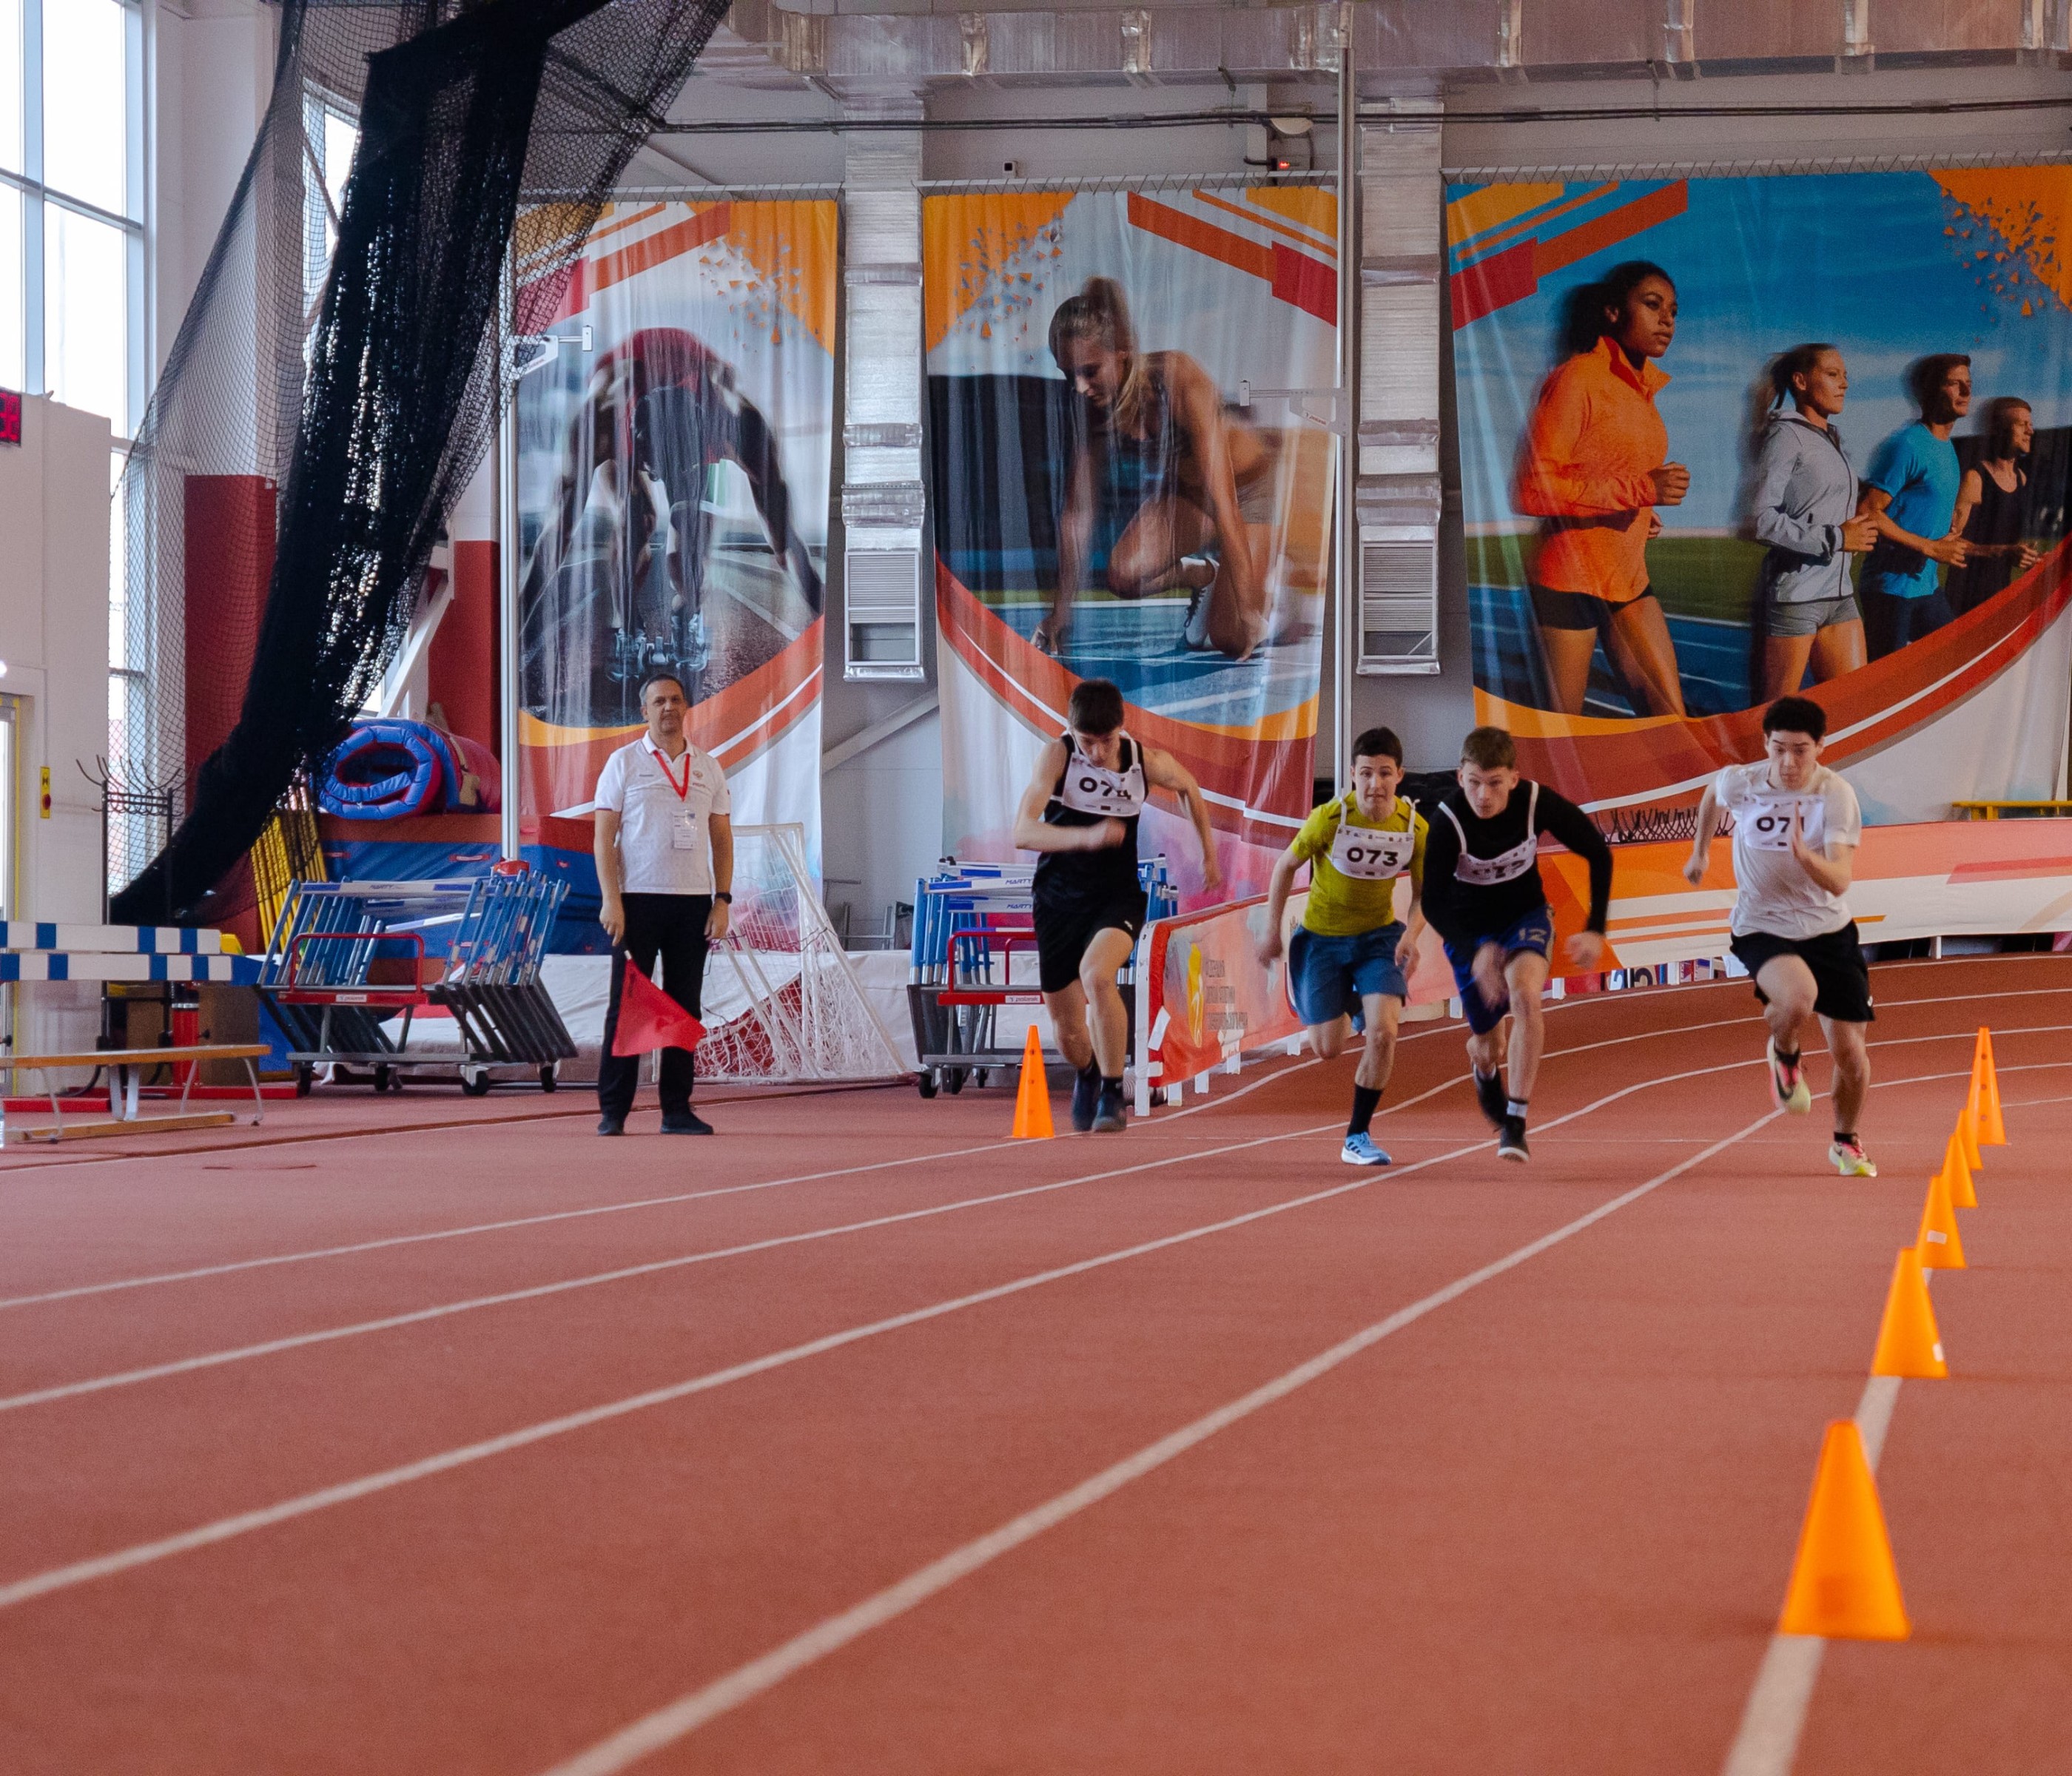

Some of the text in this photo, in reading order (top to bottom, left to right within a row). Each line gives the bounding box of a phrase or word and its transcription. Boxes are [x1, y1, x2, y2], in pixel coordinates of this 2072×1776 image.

[1079, 776, 1131, 800] 074
[1347, 847, 1399, 867] 073
[1518, 927, 1547, 945] 12
